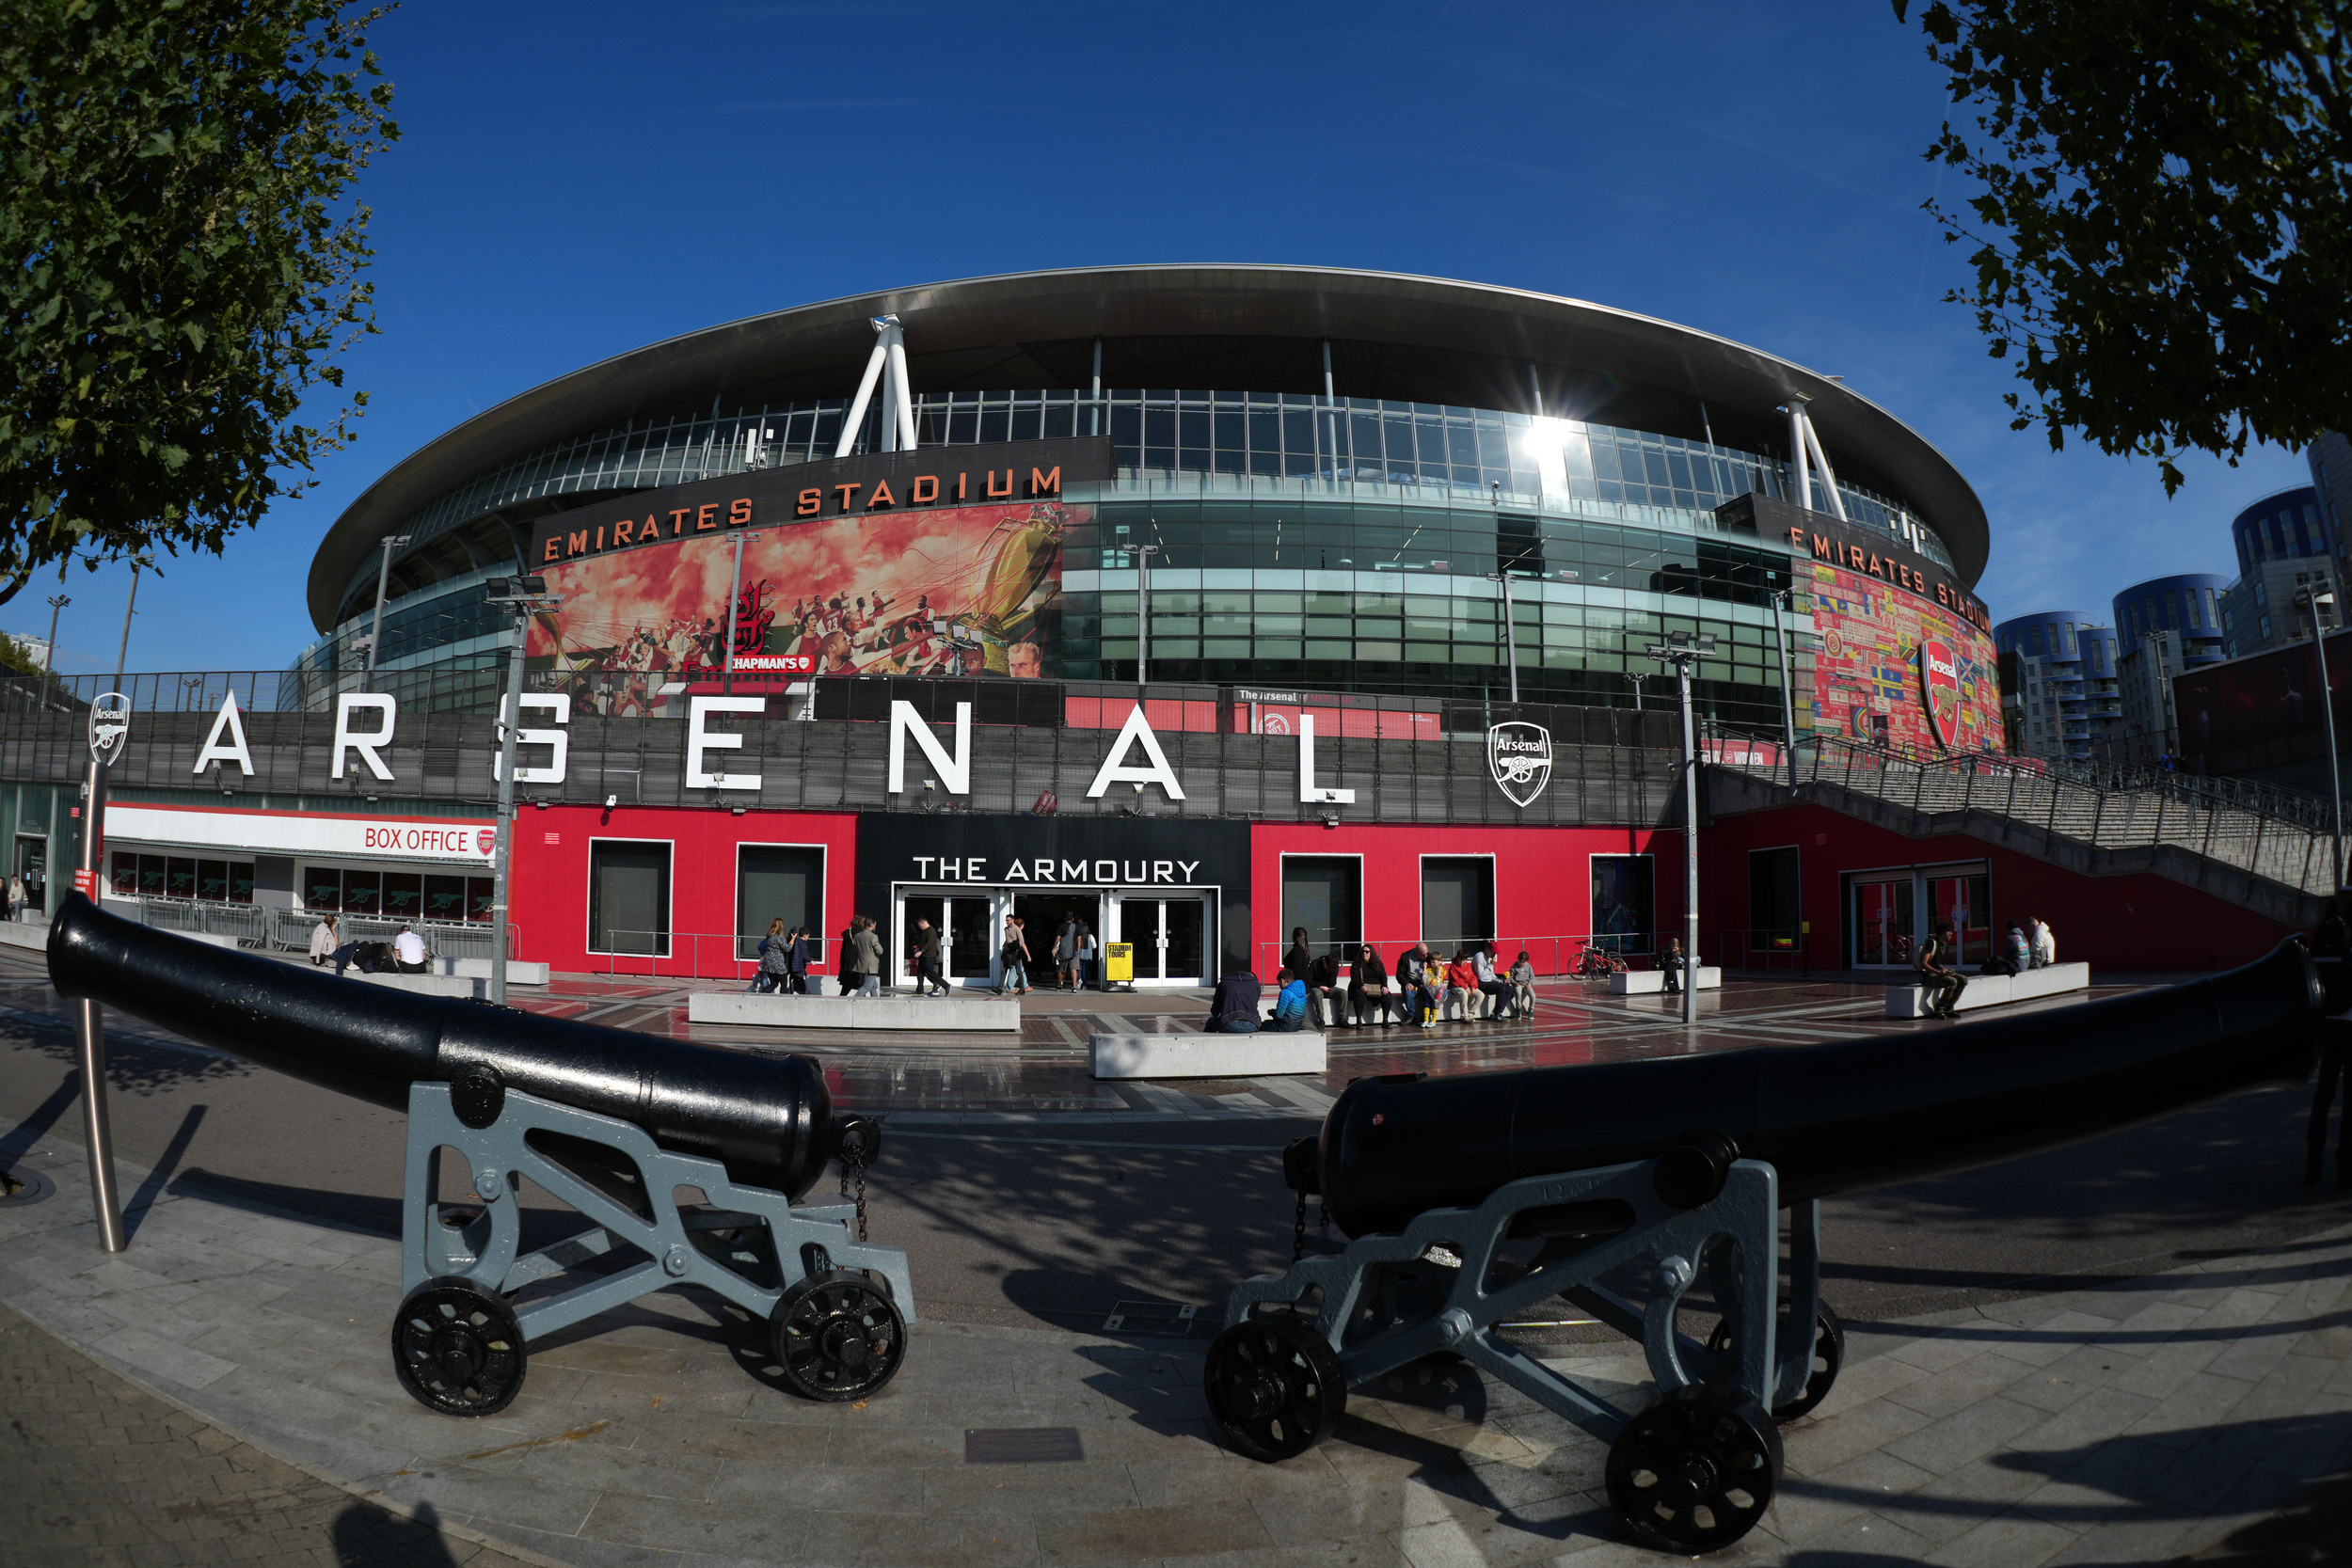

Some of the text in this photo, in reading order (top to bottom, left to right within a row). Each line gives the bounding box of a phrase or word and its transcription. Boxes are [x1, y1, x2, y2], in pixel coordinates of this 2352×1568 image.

[544, 466, 1061, 562] EMIRATES STADIUM
[1789, 527, 1993, 636] EMIRATES STADIUM
[827, 617, 837, 631] 23
[1930, 654, 1957, 679] Arsenal
[1239, 689, 1258, 700] The
[1261, 691, 1297, 702] Arsenal
[95, 707, 124, 720] Arsenal
[193, 689, 1356, 804] ARSENAL
[1497, 736, 1544, 752] Arsenal
[1733, 751, 1764, 766] WOMEN
[365, 828, 469, 852] BOX OFFICE
[913, 856, 1201, 884] THE ARMOURY
